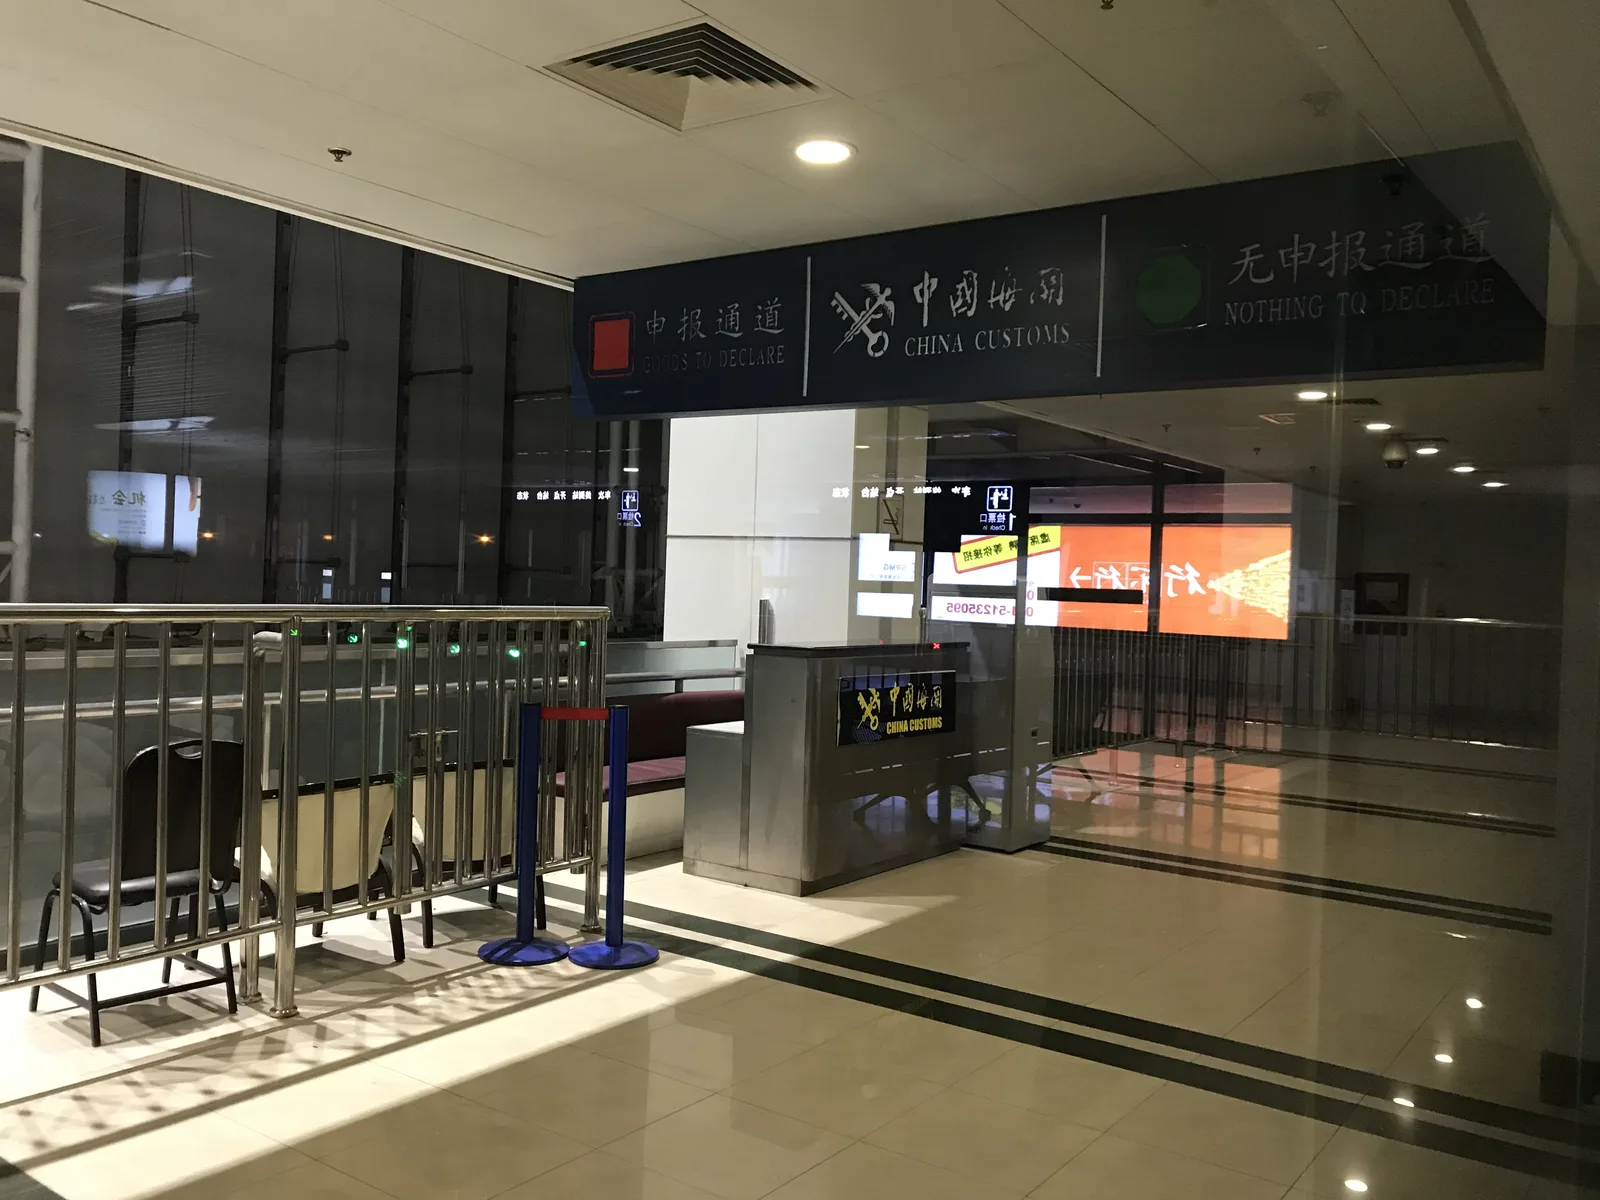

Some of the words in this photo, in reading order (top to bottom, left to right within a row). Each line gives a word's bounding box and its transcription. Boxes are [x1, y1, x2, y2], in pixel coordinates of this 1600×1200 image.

[1228, 212, 1497, 286] 无申报通道
[645, 296, 785, 346] 申报通道
[1224, 294, 1324, 326] NOTHING
[1337, 291, 1368, 316] TO
[1380, 278, 1496, 313] DECLARE
[696, 351, 712, 371] TO
[719, 345, 785, 368] DECLARE
[904, 333, 965, 358] CHINA
[975, 323, 1071, 352] CUSTOMS
[886, 720, 909, 735] CHINA
[909, 716, 943, 733] CUSTOMS
